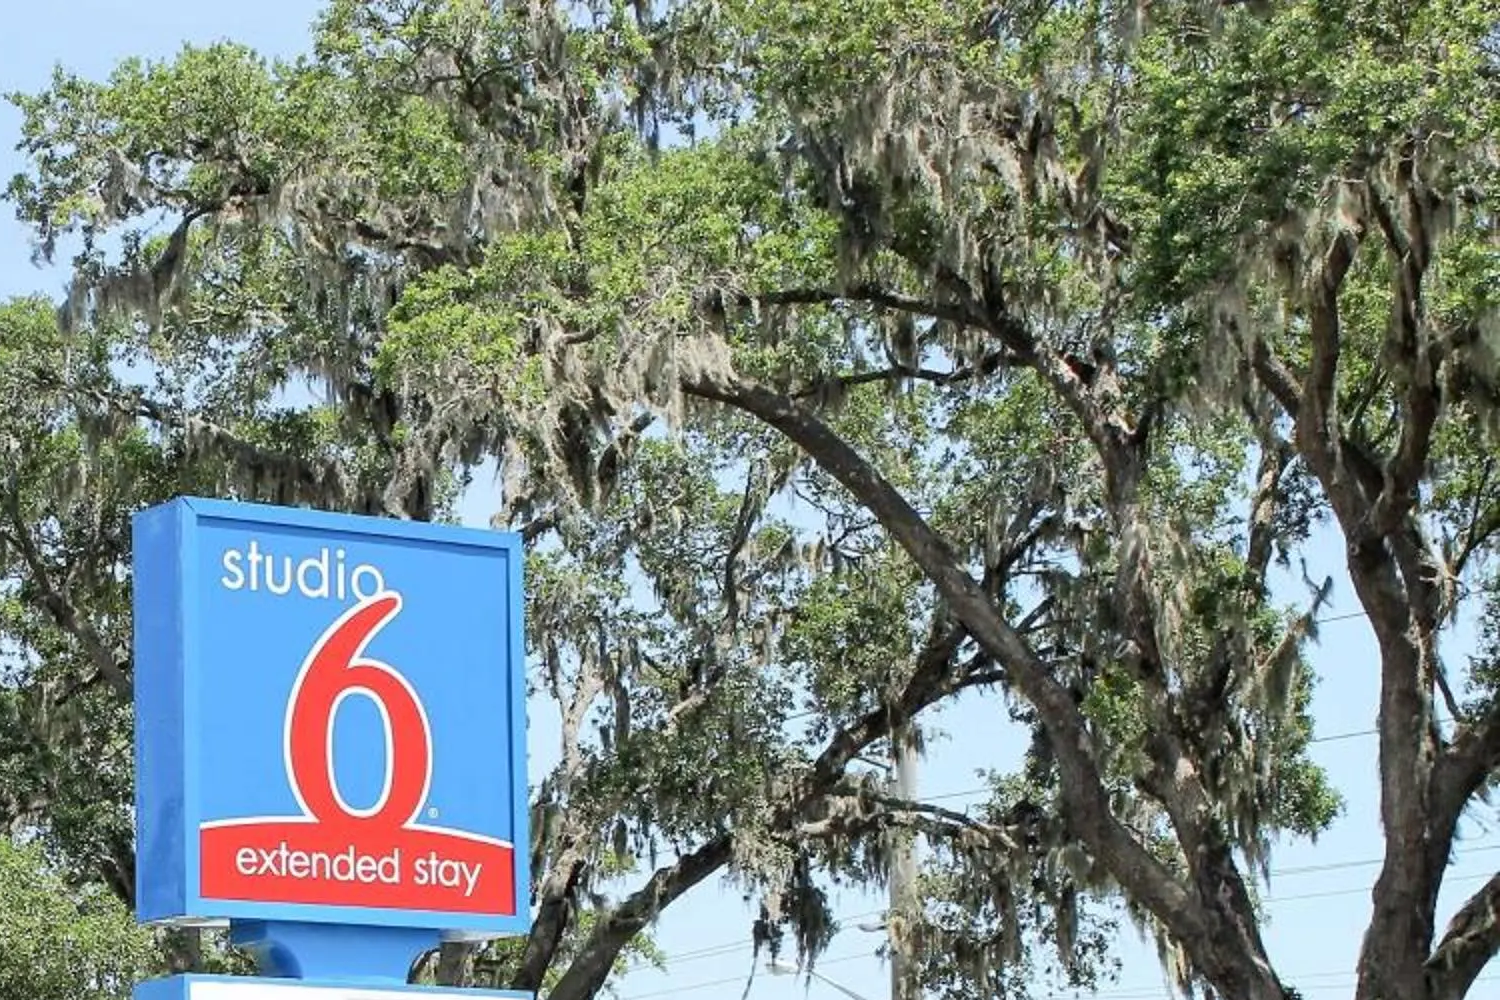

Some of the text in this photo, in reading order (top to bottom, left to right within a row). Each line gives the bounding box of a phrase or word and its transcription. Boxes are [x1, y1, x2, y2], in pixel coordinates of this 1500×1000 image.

[221, 541, 385, 601] studio
[284, 590, 433, 827] 6
[235, 841, 483, 897] extended stay
